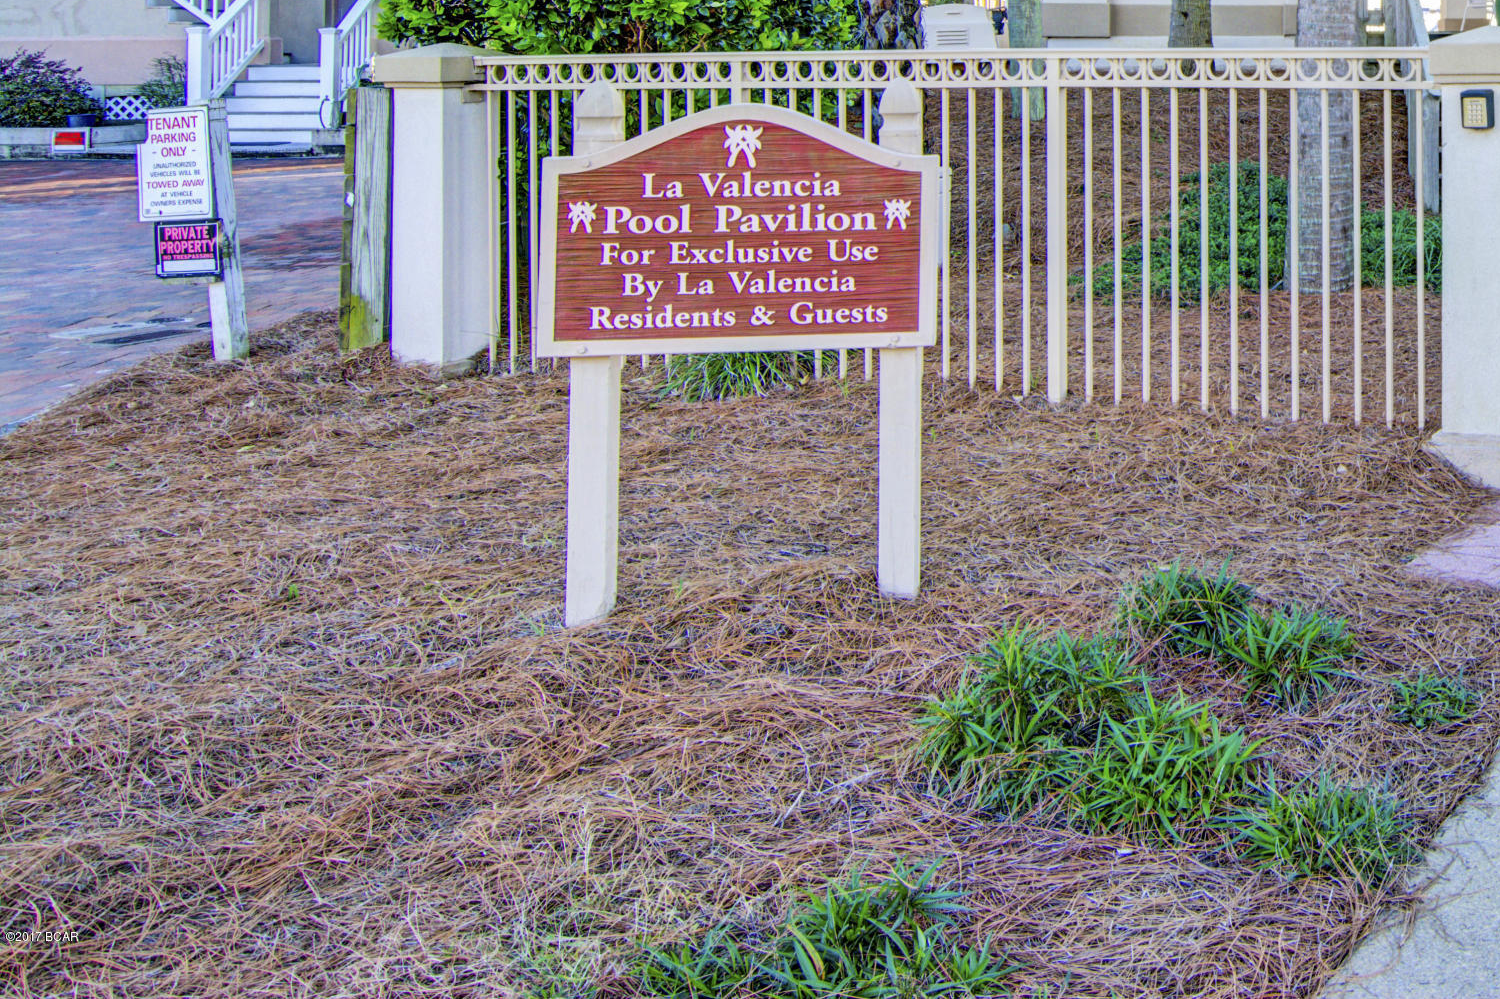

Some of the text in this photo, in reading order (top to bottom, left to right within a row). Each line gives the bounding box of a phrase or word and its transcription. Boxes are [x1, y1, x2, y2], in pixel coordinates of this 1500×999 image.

[147, 116, 198, 130] TENANT
[151, 132, 196, 143] PARKING
[161, 146, 187, 157] ONLY
[153, 161, 197, 169] UNAUTHORIZED
[147, 179, 204, 189] TOWED AWAY
[643, 171, 841, 198] La Valencia
[603, 203, 877, 235] Pool Pavilion
[164, 226, 209, 241] PRIVATE
[160, 238, 215, 254] PROPERTY
[600, 239, 879, 266] For Exclusive Use
[622, 269, 856, 302] By La Valencia
[589, 301, 889, 330] Residents & Guests
